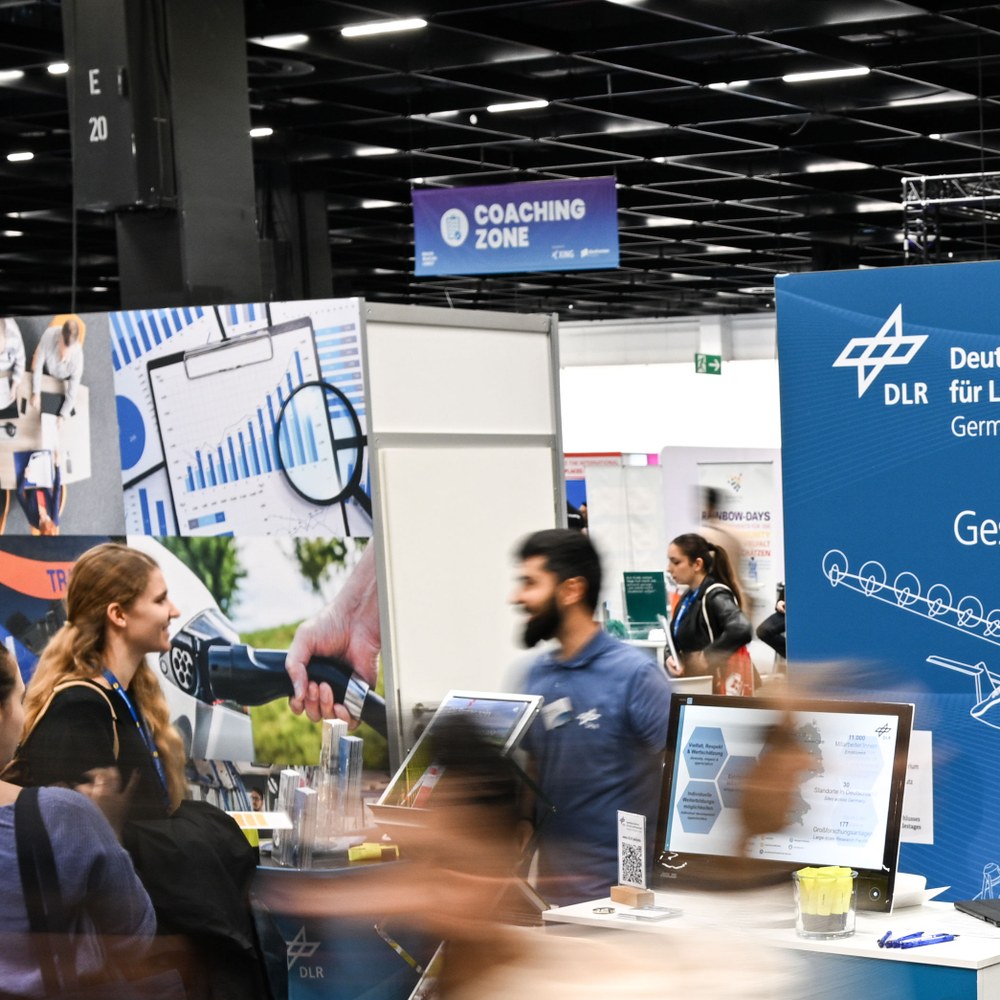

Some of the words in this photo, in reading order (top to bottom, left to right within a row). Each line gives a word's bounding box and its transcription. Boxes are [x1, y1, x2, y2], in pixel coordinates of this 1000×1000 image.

[89, 68, 101, 95] E
[89, 115, 108, 142] 20
[474, 198, 586, 226] COACHING
[475, 226, 530, 250] ZONE
[884, 383, 929, 406] DLR
[949, 379, 982, 404] für
[299, 966, 324, 979] DLR
